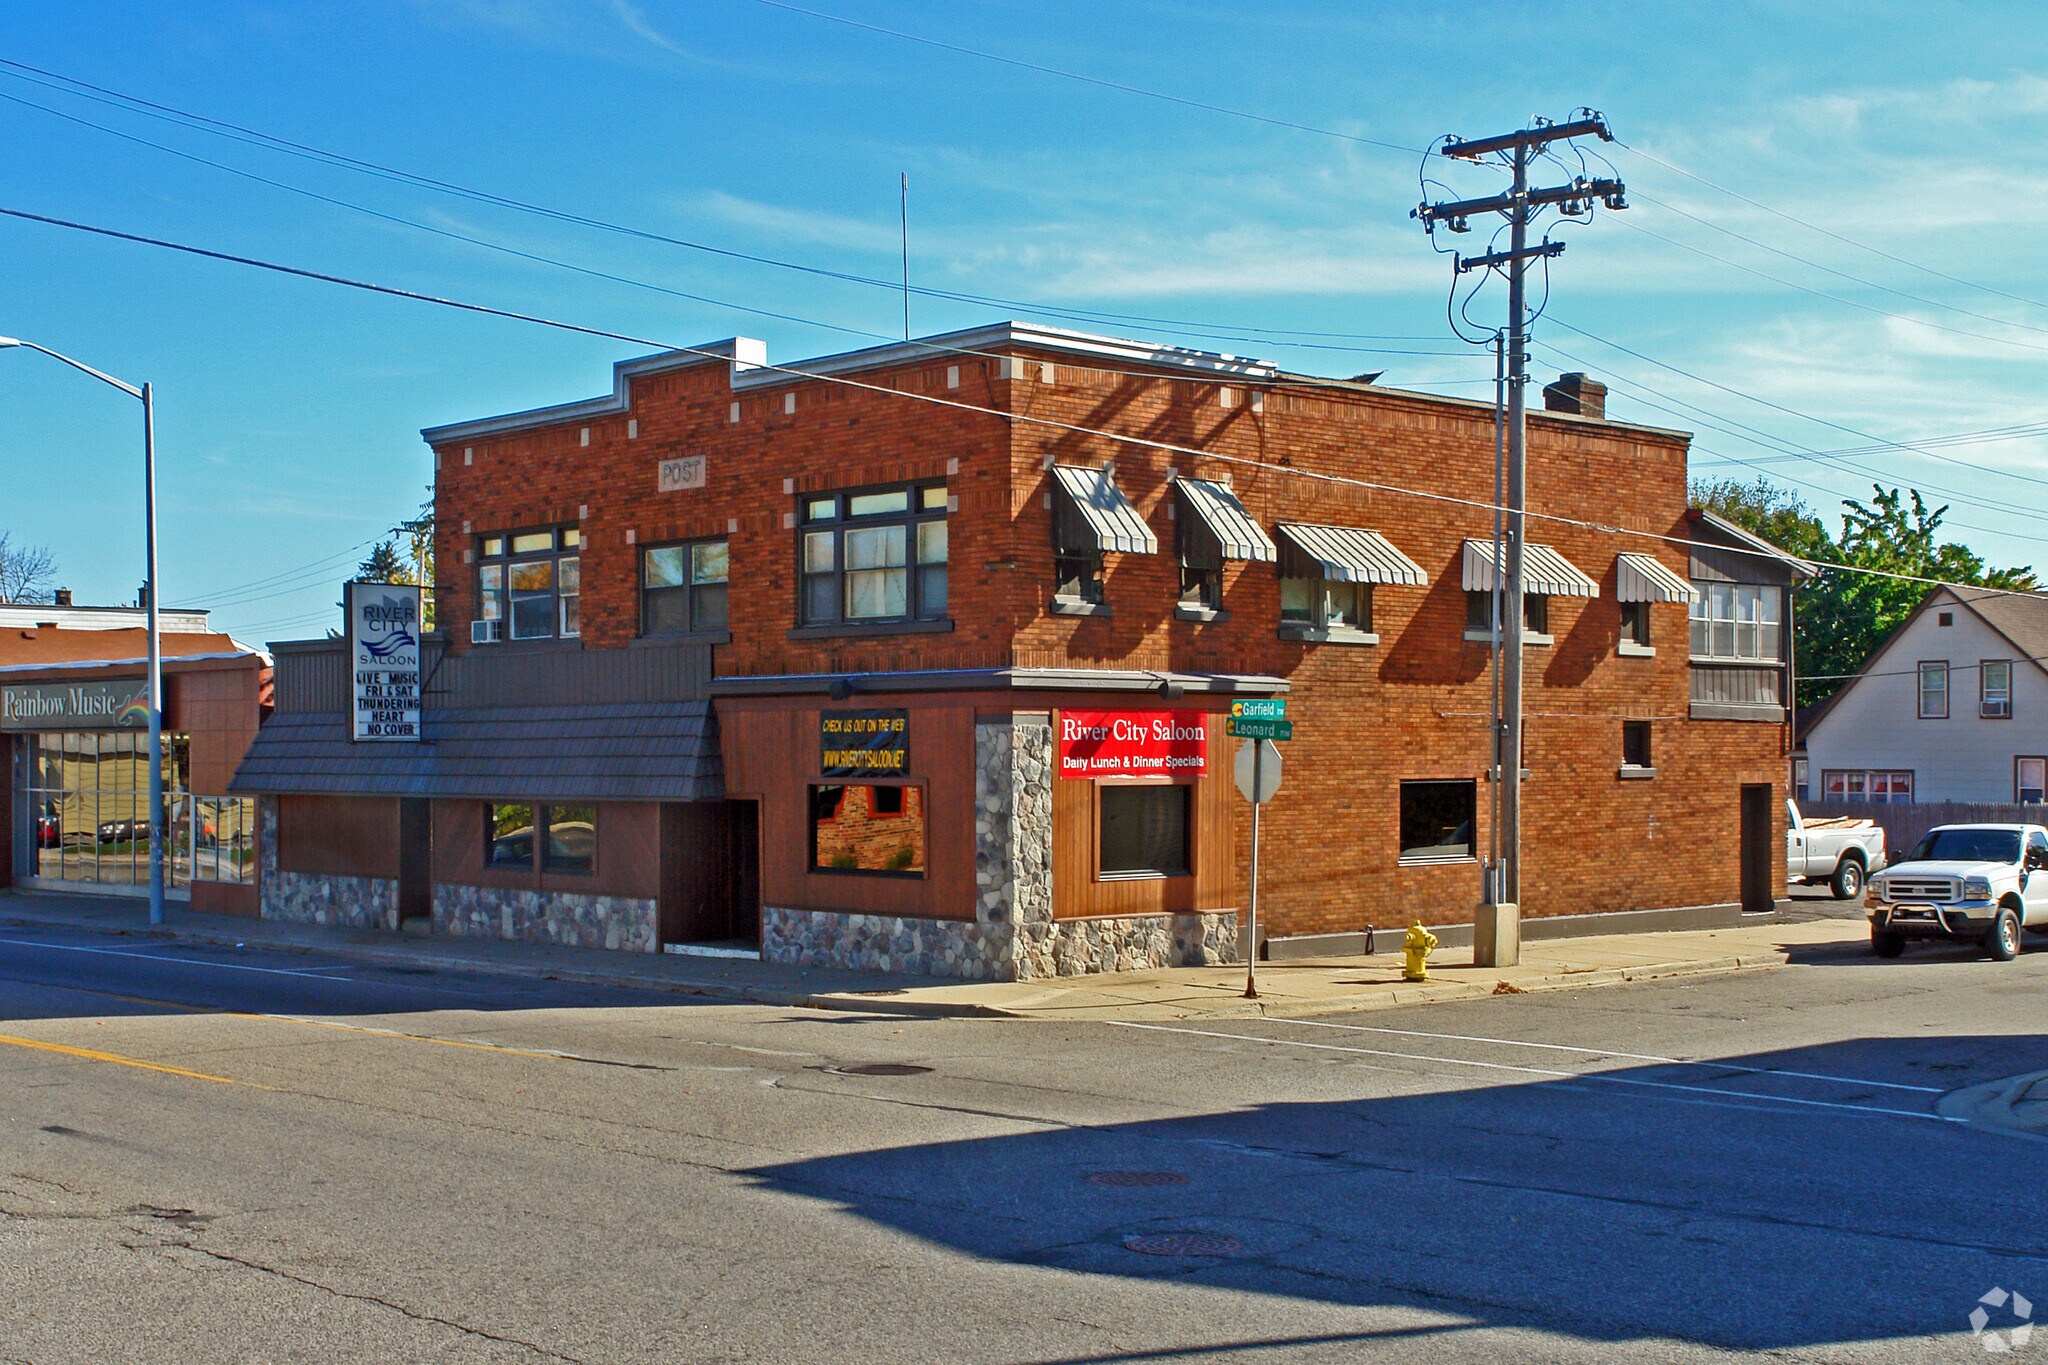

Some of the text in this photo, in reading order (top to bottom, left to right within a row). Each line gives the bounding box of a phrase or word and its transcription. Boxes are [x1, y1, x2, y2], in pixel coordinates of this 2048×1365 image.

[663, 460, 701, 485] POST
[364, 606, 415, 619] RIVER
[369, 619, 409, 632] CITY
[360, 655, 416, 665] SALOON
[357, 672, 418, 684] LIVE MUSIC
[366, 685, 382, 696] FRI
[395, 686, 413, 696] SAT
[4, 687, 116, 721] Rainbow Music
[358, 698, 419, 709] THUNDERING
[1242, 702, 1274, 716] Garfield
[372, 711, 404, 721] HEART
[368, 724, 414, 735] NO COVER
[854, 720, 866, 732] OUT
[868, 720, 877, 732] ON
[878, 719, 890, 731] THE
[1062, 718, 1205, 746] River City Saloon
[1235, 721, 1275, 736] Leonard
[1063, 755, 1204, 771] Daily Lunch & Dinner Specials
